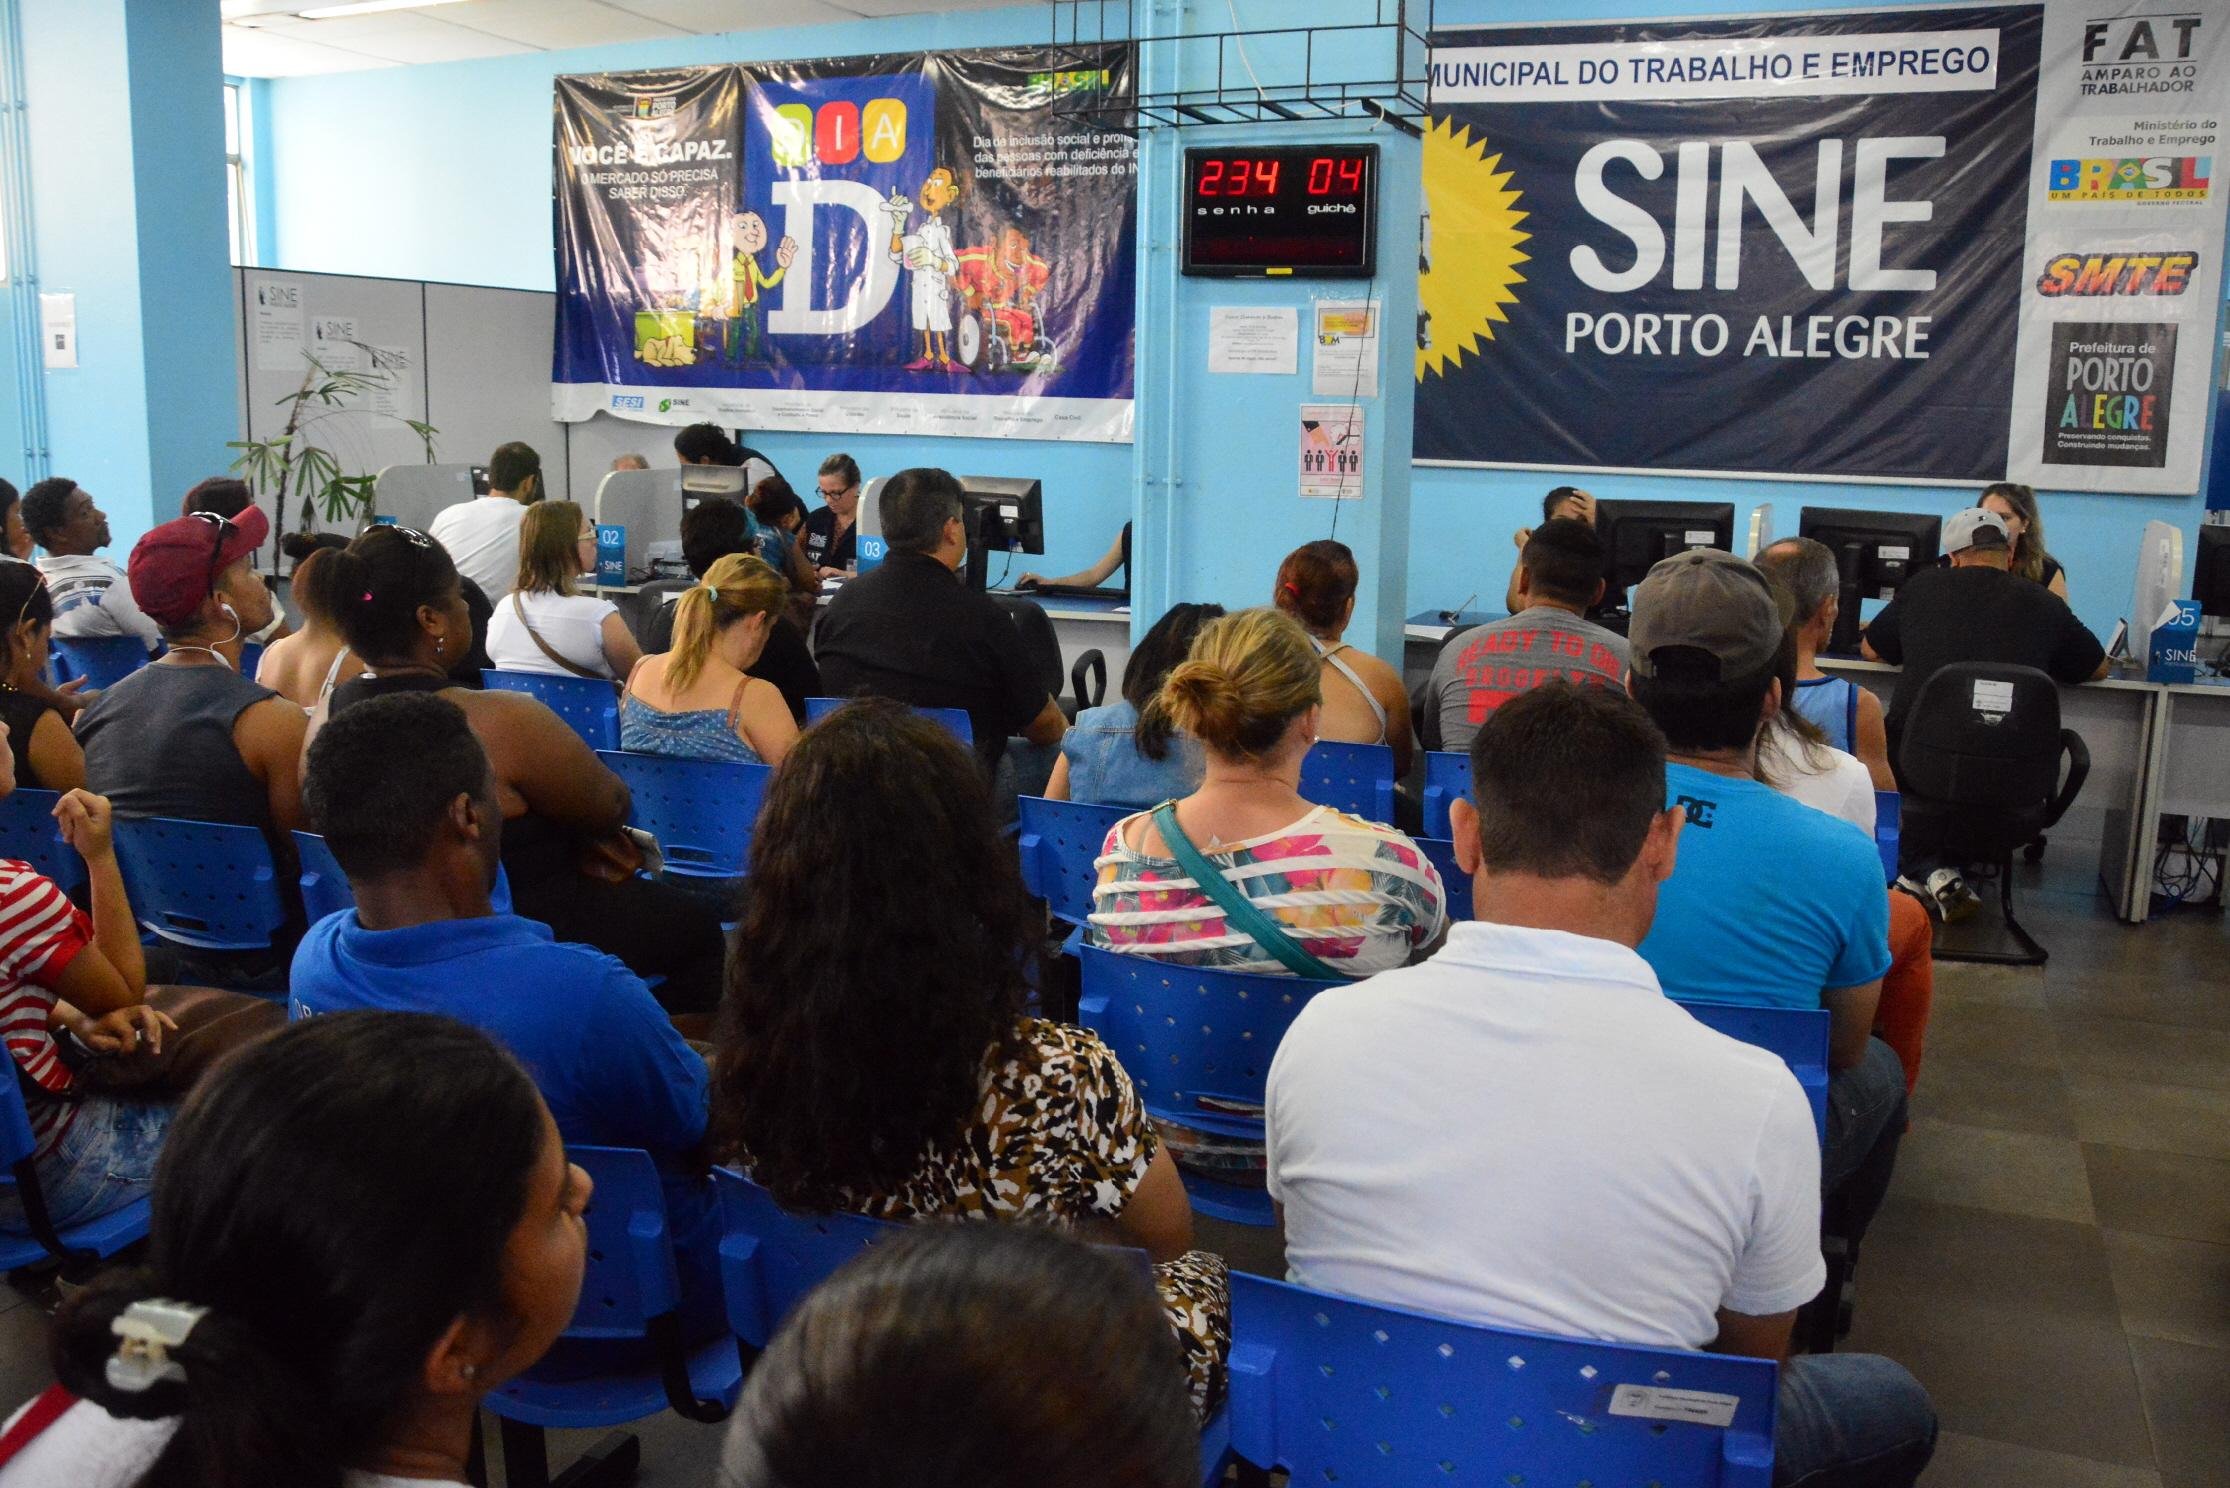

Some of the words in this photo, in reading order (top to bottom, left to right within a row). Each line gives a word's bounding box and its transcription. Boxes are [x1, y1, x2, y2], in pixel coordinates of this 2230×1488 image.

[2082, 18, 2202, 62] FAT
[1425, 61, 1568, 88] MUNICIPAL
[1578, 58, 1620, 85] DO
[1630, 54, 1792, 84] TRABALHO
[1804, 52, 1820, 79] E
[1832, 46, 1990, 78] EMPREGO
[2081, 66, 2161, 81] AMPARO
[2169, 65, 2196, 78] AO
[2081, 80, 2194, 95] TRABALHADOR
[2134, 119, 2197, 131] Ministério
[2200, 119, 2217, 129] do
[973, 136, 991, 148] Dia
[993, 136, 1007, 147] de
[1009, 133, 1055, 147] inclusão
[1057, 132, 1090, 145] social
[1093, 134, 1101, 144] e
[2089, 135, 2144, 146] Trabalho
[2147, 137, 2155, 145] e
[2159, 135, 2216, 146] Emprego
[570, 142, 628, 165] VOCÊ
[974, 152, 994, 163] das
[996, 151, 1041, 164] pessoas
[1044, 151, 1068, 161] com
[1070, 147, 1129, 160] deficiência
[590, 171, 649, 185] MERCADO
[651, 169, 668, 184] SÓ
[670, 168, 719, 183] PRECISA
[1044, 163, 1108, 176] reabilitados
[1111, 163, 1125, 175] do
[1199, 160, 1279, 196] 234
[1307, 158, 1363, 194] 04
[609, 186, 647, 199] SABER
[2051, 192, 2071, 200] UM
[2126, 191, 2144, 199] DE
[2155, 190, 2206, 198] TODOS
[1197, 204, 1275, 216] senha
[1307, 203, 1356, 215] guichê
[1570, 136, 1946, 293] SINE
[2038, 252, 2197, 296] SMTE
[270, 286, 297, 302] SINE
[1565, 312, 1729, 356] PORTO
[1743, 314, 1933, 359] ALEGRE
[2069, 341, 2136, 354] Prefeitura
[2138, 342, 2157, 353] de
[2066, 357, 2154, 391] PORTO
[2059, 393, 2157, 430] ALEGRE
[2058, 432, 2106, 440] Preservando
[2057, 441, 2106, 449] Construindo
[602, 530, 619, 544] 02
[864, 541, 880, 557] 03
[604, 560, 623, 570] SINE
[1550, 630, 1584, 657] TO
[2165, 649, 2196, 662] SINE
